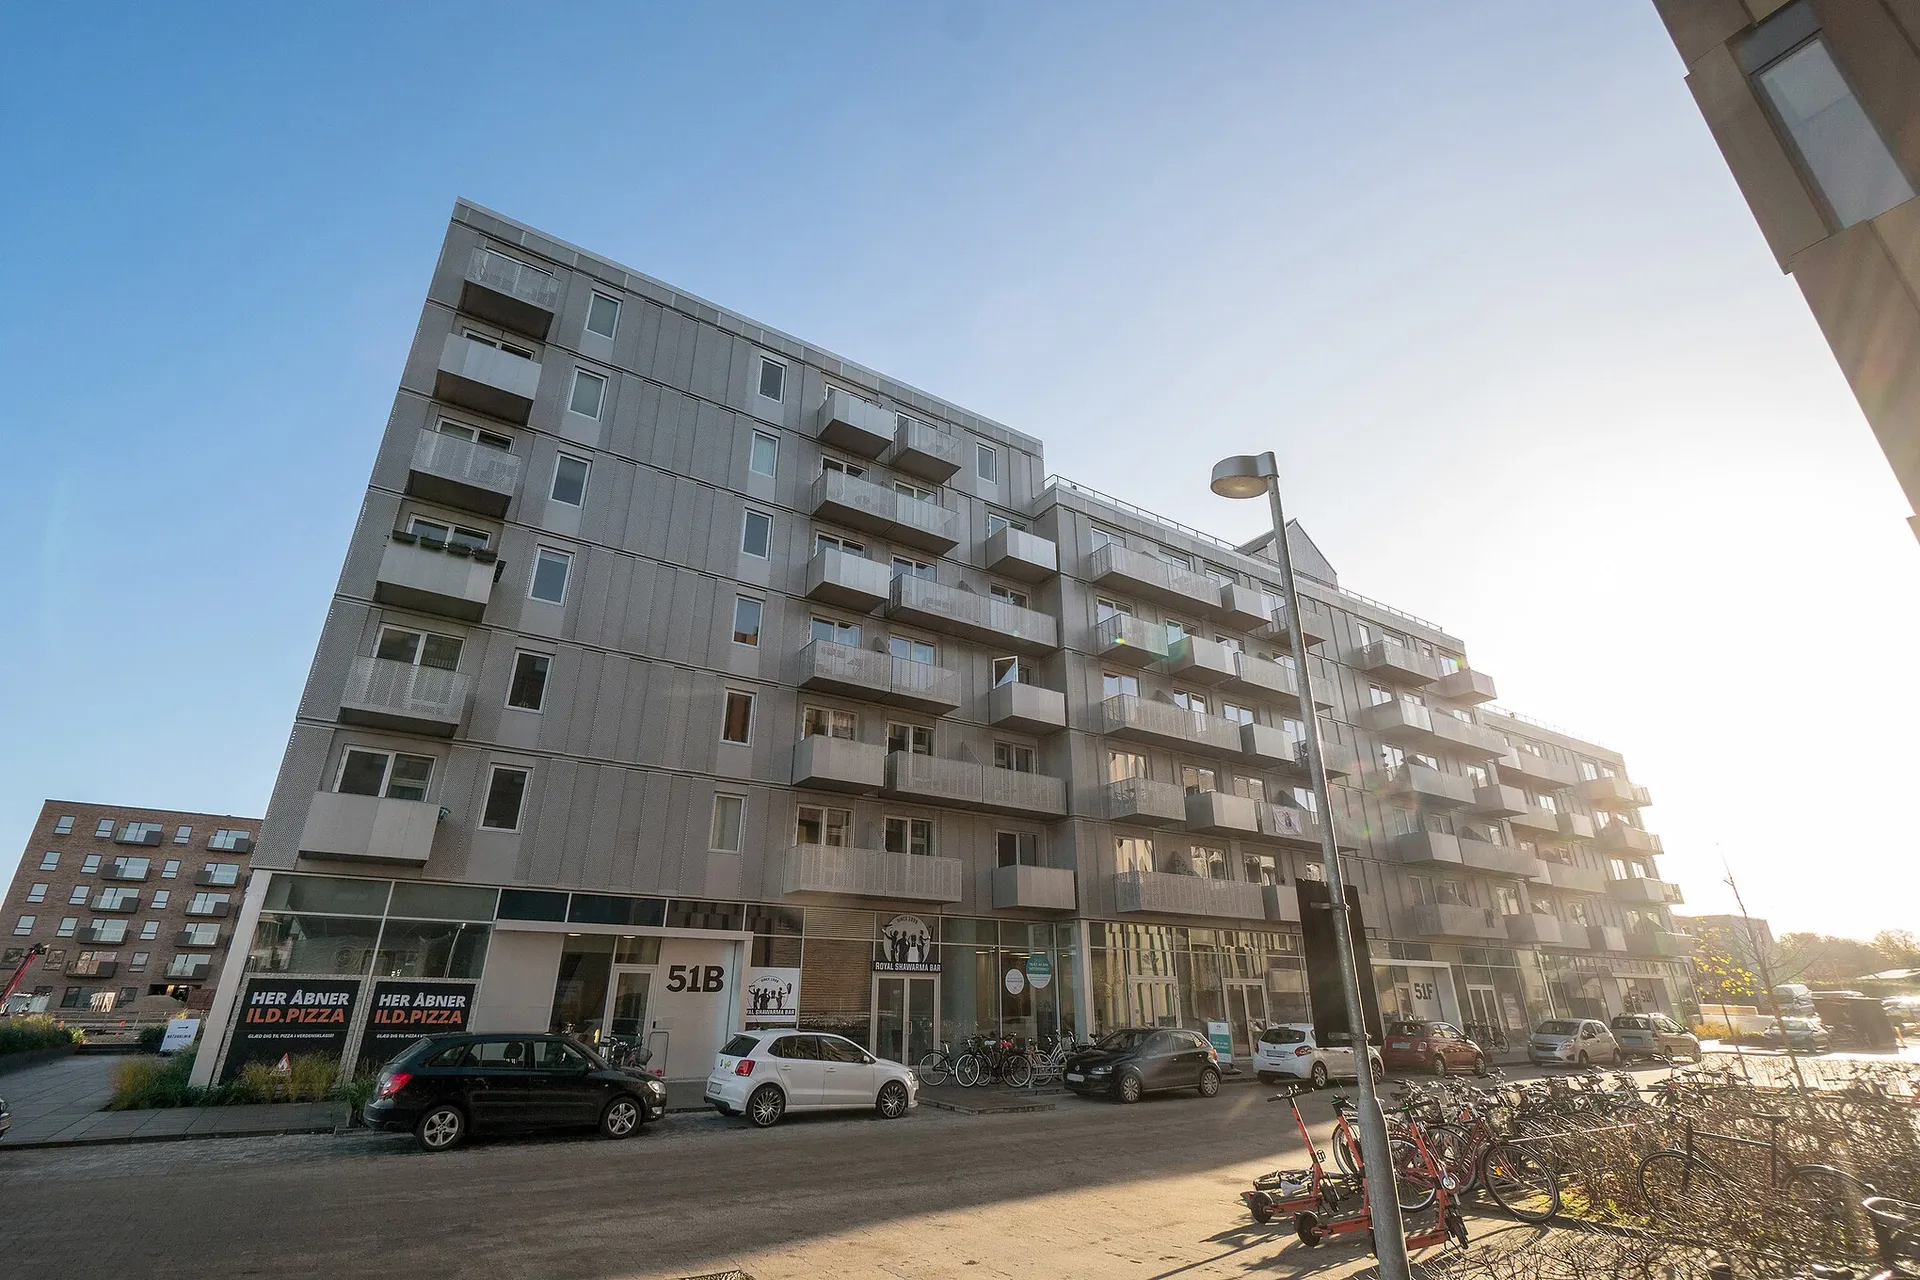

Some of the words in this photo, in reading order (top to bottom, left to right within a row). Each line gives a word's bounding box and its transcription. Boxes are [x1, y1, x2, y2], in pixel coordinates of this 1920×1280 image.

[876, 962, 894, 970] ROYAL
[895, 962, 928, 972] SHAWARMA
[666, 965, 724, 992] 51B
[251, 992, 287, 1004] HER
[290, 990, 350, 1006] ÅBNER
[1414, 982, 1432, 1000] 51F
[378, 994, 410, 1006] HER
[412, 992, 466, 1008] ÅBNER
[246, 1008, 344, 1022] ILD.PIZZA
[374, 1010, 462, 1024] ILD.PIZZA
